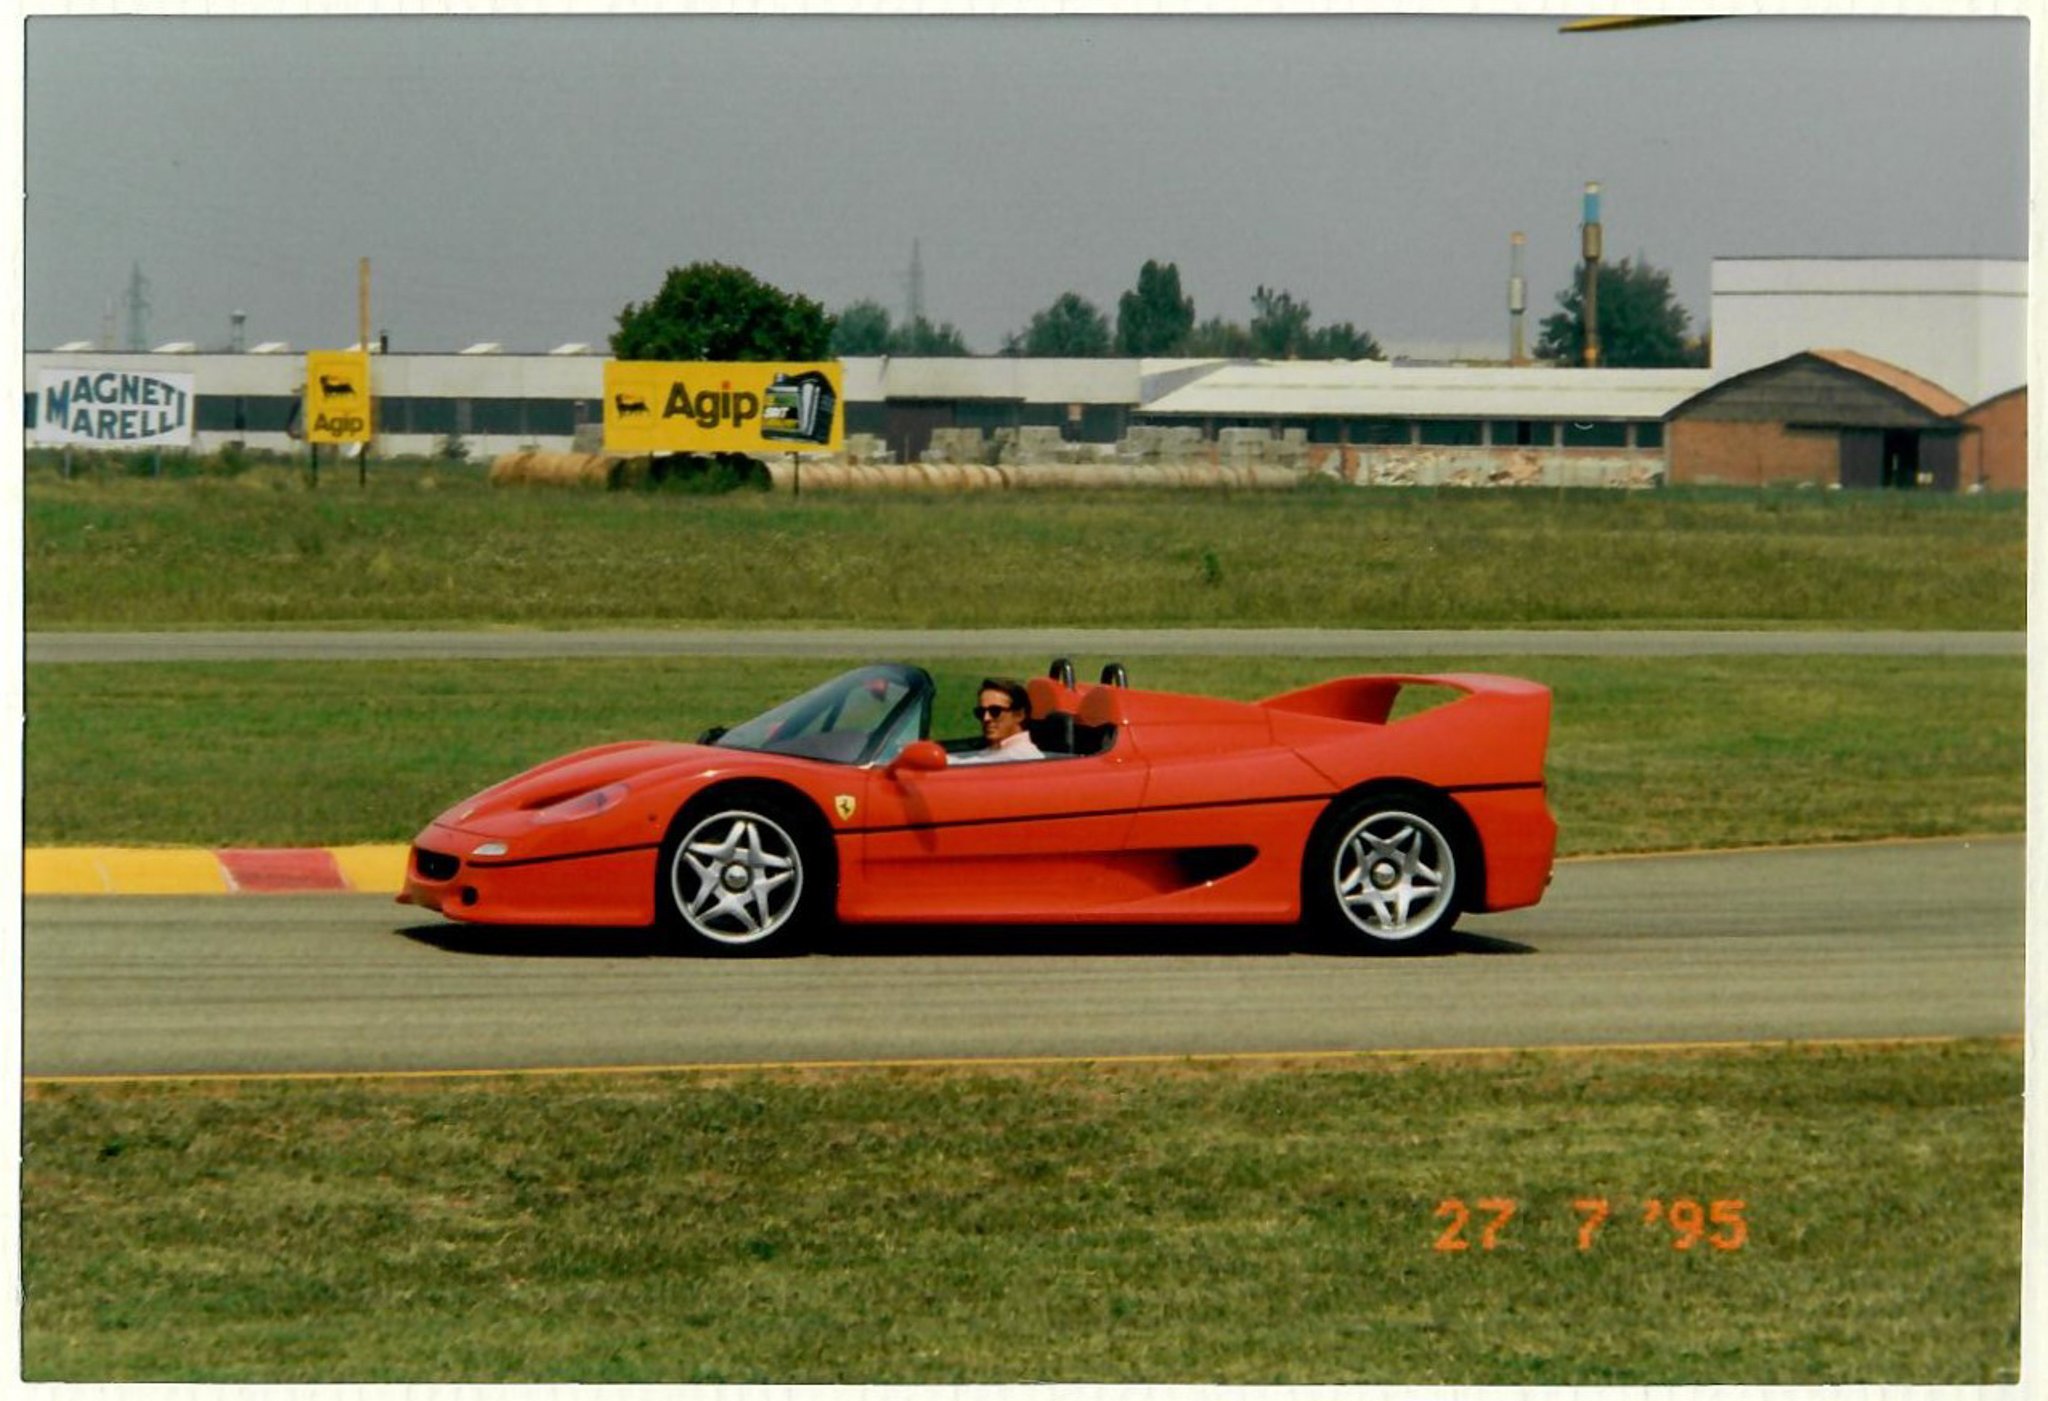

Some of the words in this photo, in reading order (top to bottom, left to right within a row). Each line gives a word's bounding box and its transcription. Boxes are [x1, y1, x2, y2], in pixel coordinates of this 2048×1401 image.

[46, 373, 186, 420] MAGNETI
[662, 381, 760, 429] Agip
[313, 411, 364, 438] Agip
